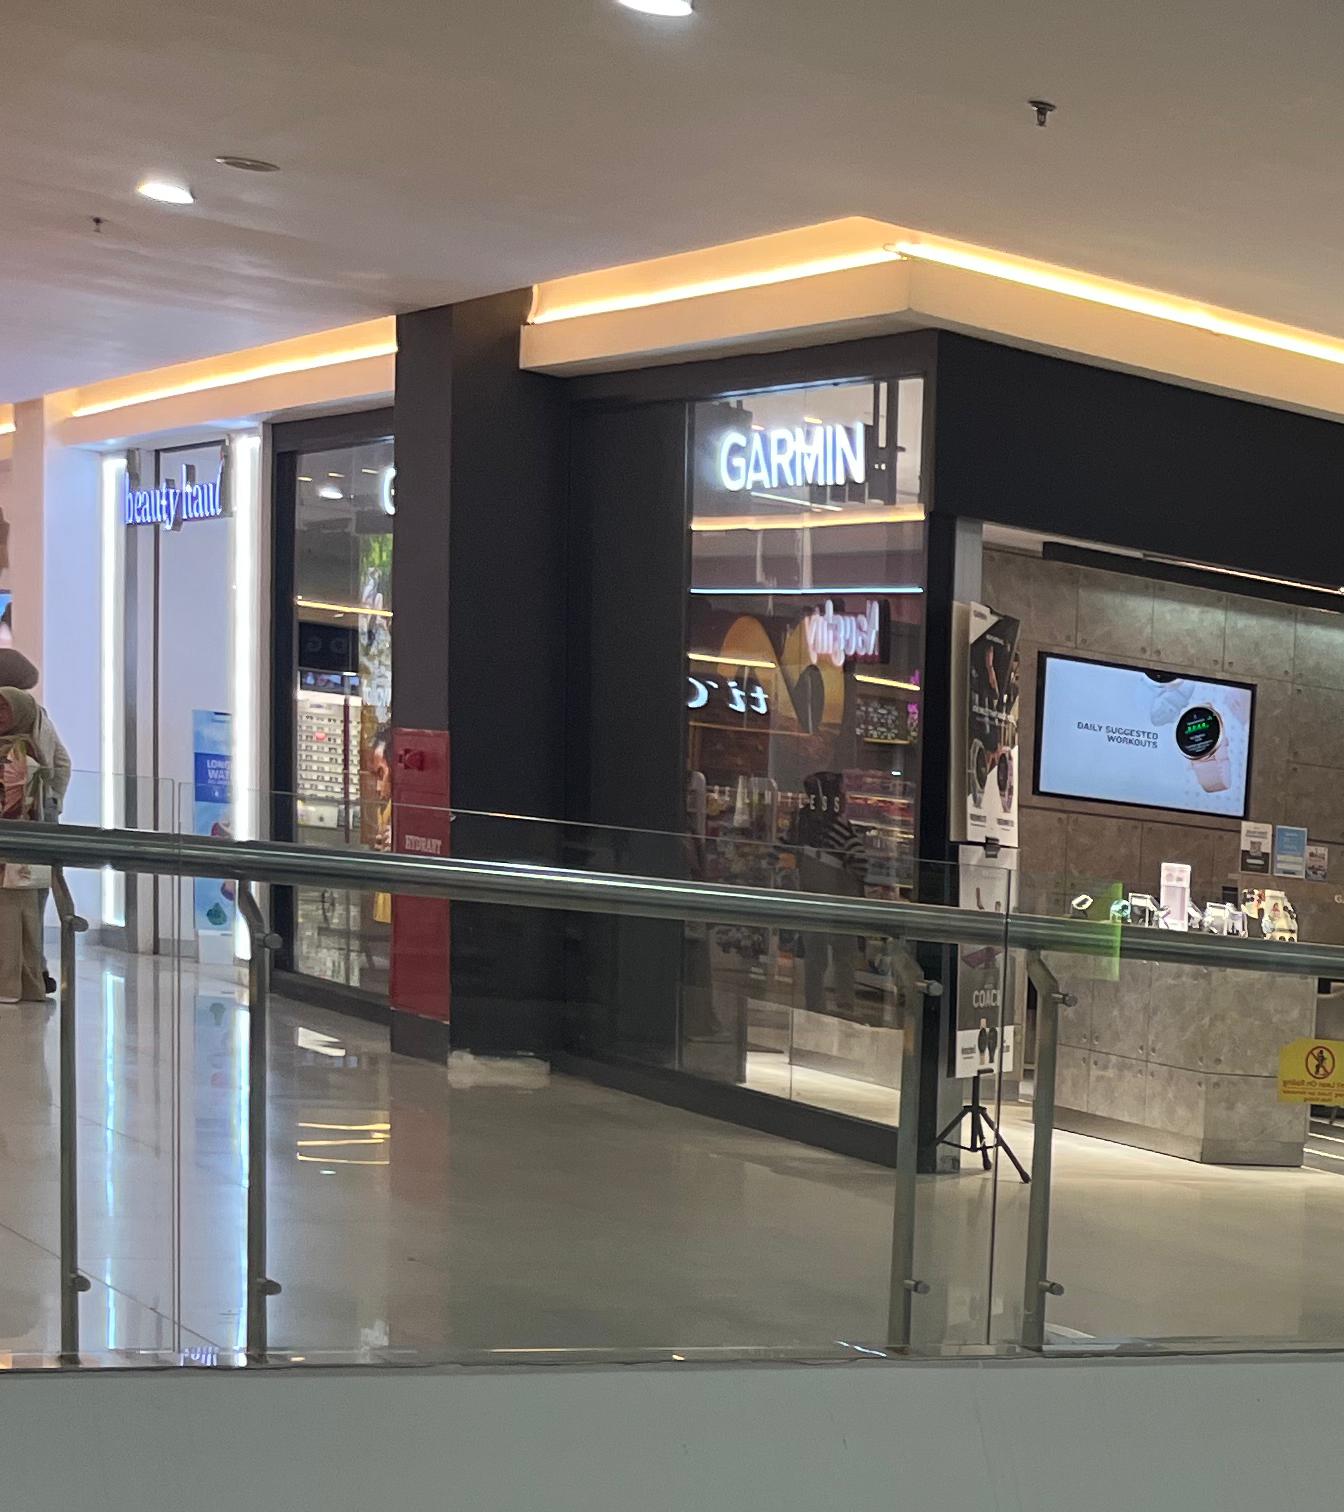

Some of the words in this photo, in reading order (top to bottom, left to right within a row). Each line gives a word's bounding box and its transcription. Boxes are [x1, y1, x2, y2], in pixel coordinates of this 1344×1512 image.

[720, 421, 866, 492] GARMIN
[125, 471, 181, 530] beauty
[182, 459, 223, 519] haul
[1077, 721, 1103, 732] DAILY
[1105, 725, 1159, 740] SUGGESTED
[1107, 735, 1158, 749] WORKOUTS
[405, 834, 442, 855] HYDRANT
